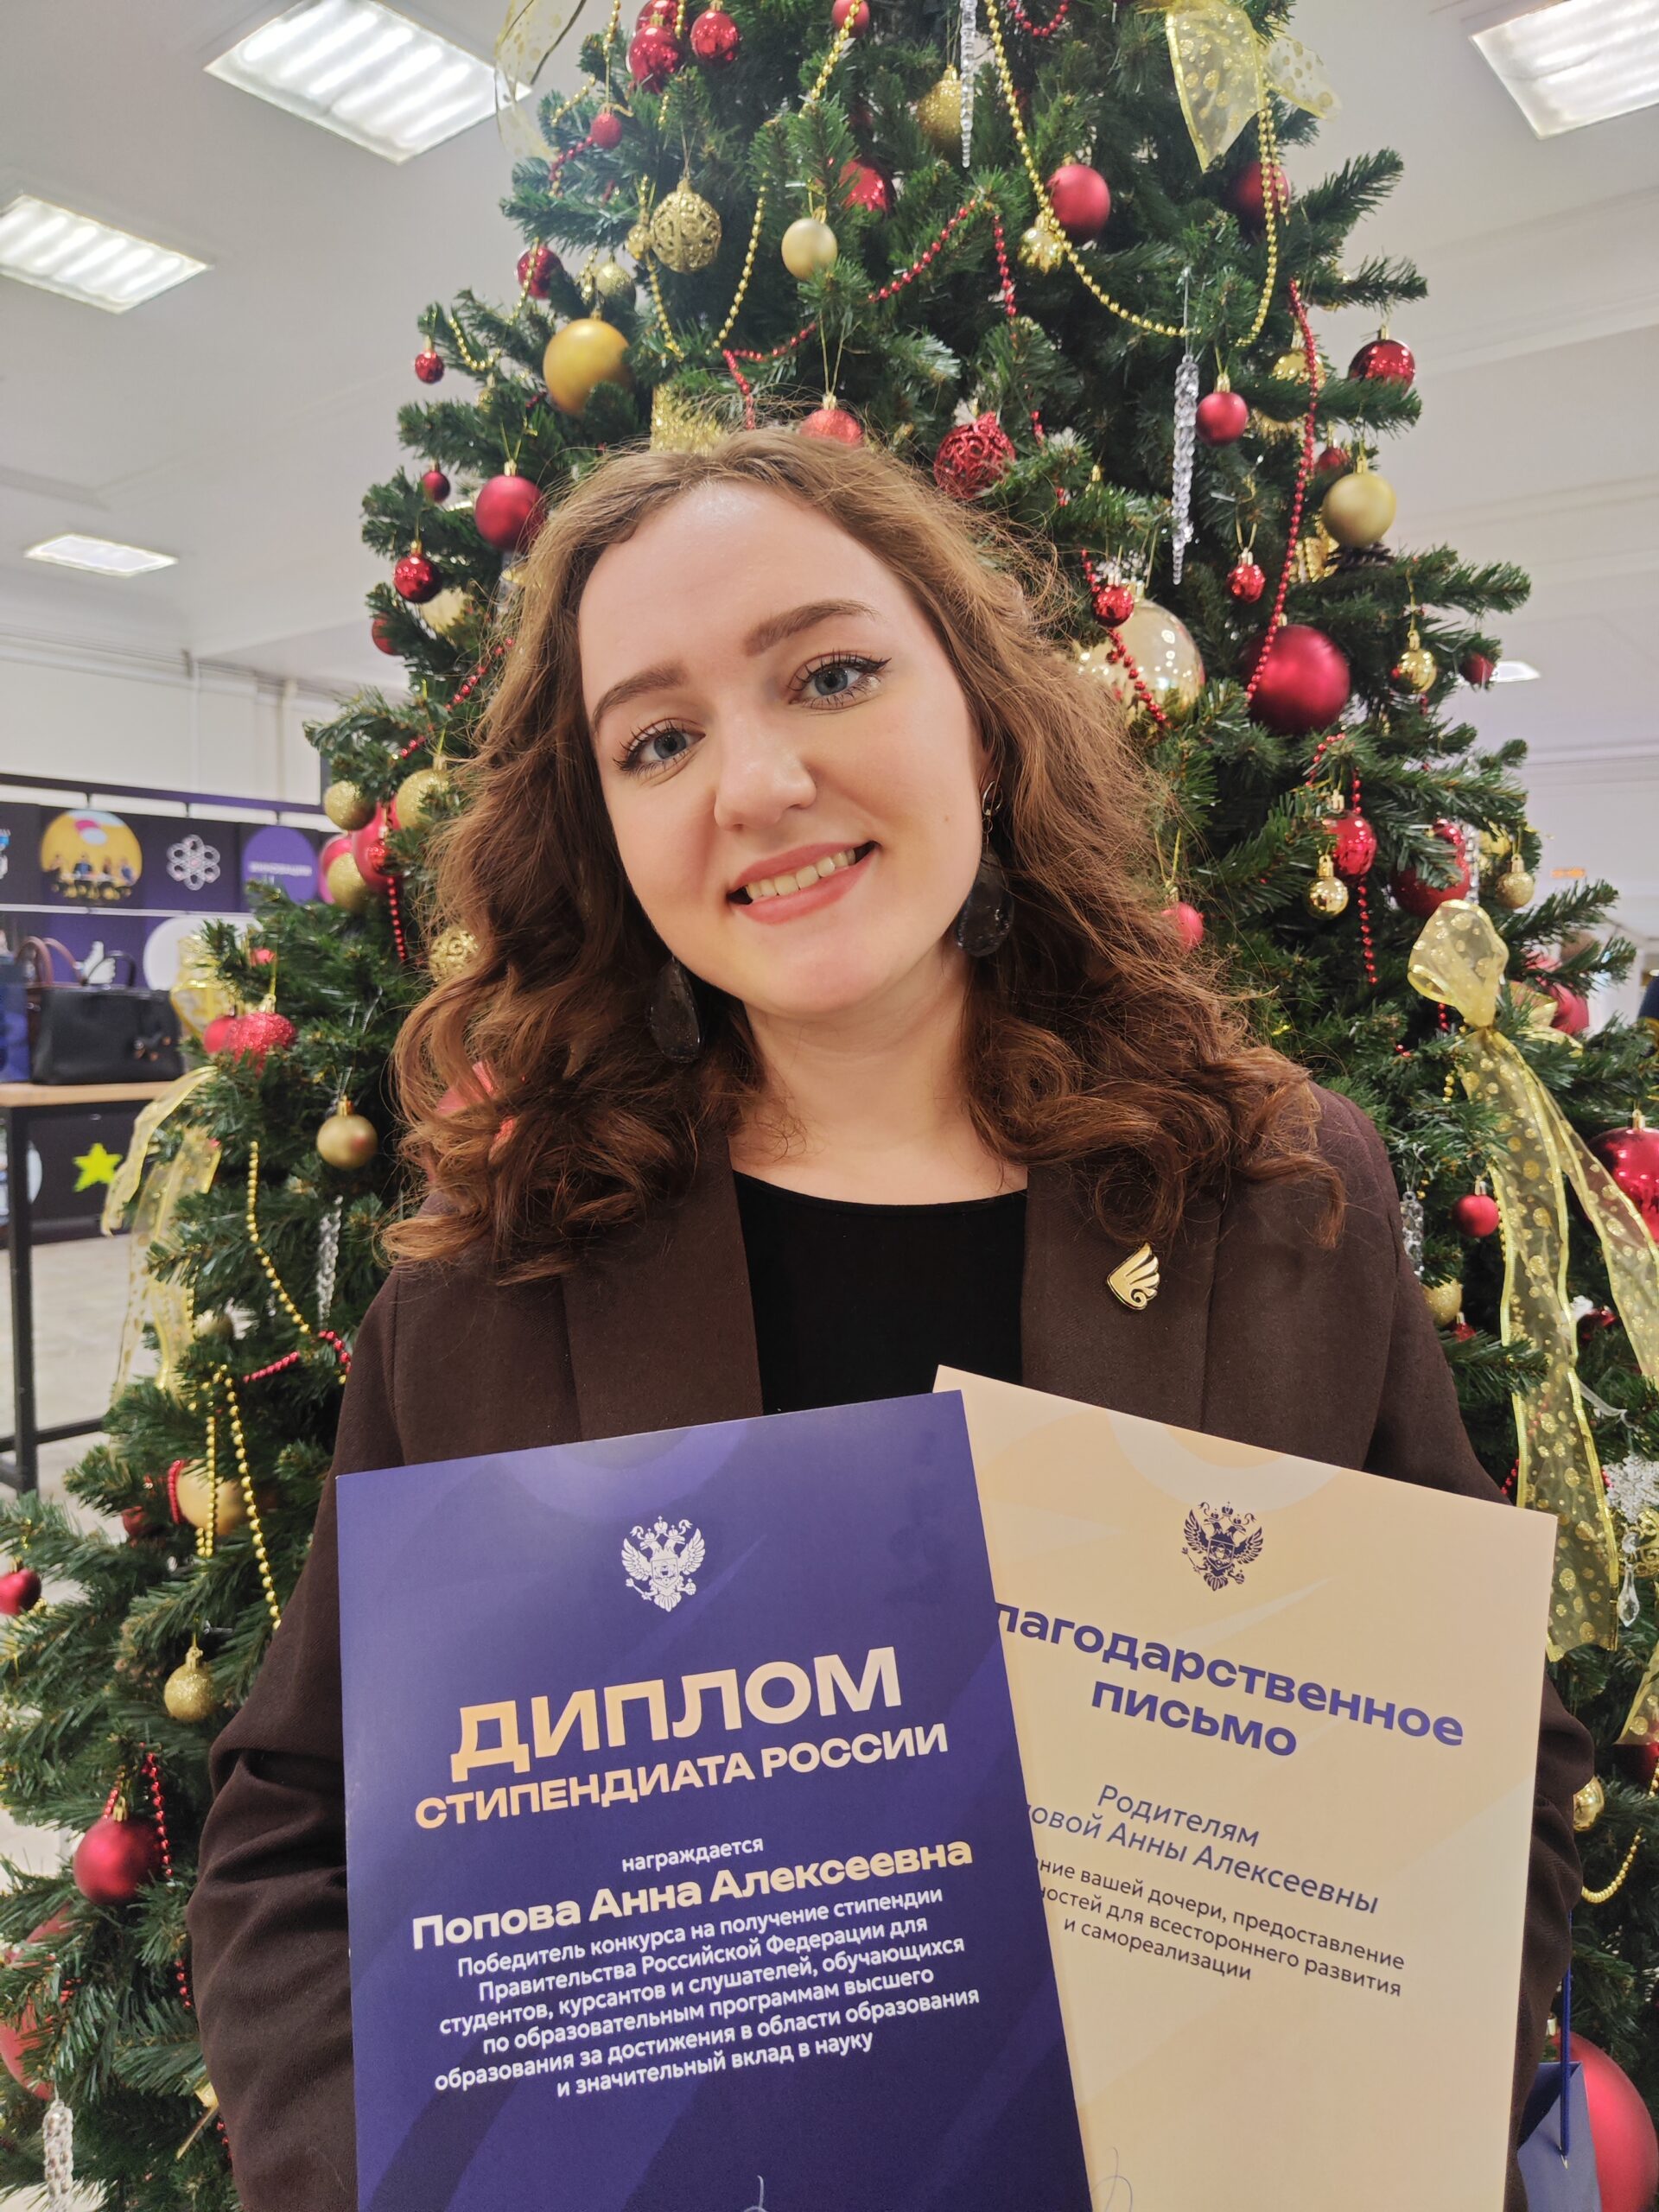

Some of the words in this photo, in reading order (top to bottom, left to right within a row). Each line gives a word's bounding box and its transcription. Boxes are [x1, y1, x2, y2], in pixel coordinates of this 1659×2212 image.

[450, 1646, 902, 1783] ДИПЛОМ
[994, 1600, 1464, 1746] лагодарственное
[1091, 1681, 1297, 1757] письмо
[415, 1751, 756, 1829] СТИПЕНДИАТА
[760, 1723, 949, 1778] РОССИИ
[1097, 1784, 1260, 1847] Родителям
[412, 1900, 582, 1950] Попова
[588, 1881, 702, 1922] Анна
[709, 1840, 973, 1903] Алексеевна
[621, 1838, 764, 1872] награждается
[1027, 1803, 1103, 1839] овой
[1105, 1822, 1188, 1862] Анны
[1192, 1845, 1378, 1914] Алексеевны
[458, 1944, 586, 1978] Победитель
[590, 1927, 686, 1956] конкурса
[690, 1923, 715, 1940] на
[720, 1905, 830, 1936] получение
[833, 1888, 943, 1917] стипендии
[1036, 1858, 1076, 1879] ние
[1080, 1870, 1144, 1898] вашей
[1147, 1889, 1227, 1923] дочери,
[1233, 1911, 1405, 1970] предоставление
[1064, 1918, 1076, 1932] и
[1081, 1923, 1251, 1980] самореализации
[1105, 1904, 1144, 1925] для
[1149, 1916, 1300, 1967] всестороннего
[1304, 1958, 1401, 1997] развития
[439, 2003, 554, 2035] студентов,
[558, 1984, 666, 2018] курсантов
[671, 1980, 684, 1997] и
[688, 1955, 818, 1995] слушателей,
[822, 1937, 965, 1974] обучающихся
[479, 1962, 637, 2005] Правительства
[641, 1936, 762, 1975] Российской
[766, 1923, 886, 1955] Федерации
[889, 1917, 928, 1940] для
[434, 2053, 575, 2091] образования
[579, 2049, 603, 2067] за
[607, 2027, 736, 2066] достижения
[741, 2024, 753, 2040] в
[757, 2010, 842, 2037] области
[845, 1989, 980, 2024] образования
[483, 2036, 510, 2055] по
[513, 2004, 705, 2050] образовательным
[709, 1982, 840, 2019] программам
[843, 1968, 934, 1996] высшего
[556, 2081, 570, 2098] и
[575, 2050, 727, 2094] значительный
[731, 2044, 795, 2069] вклад
[798, 2042, 810, 2058] в
[815, 2031, 874, 2056] науку
